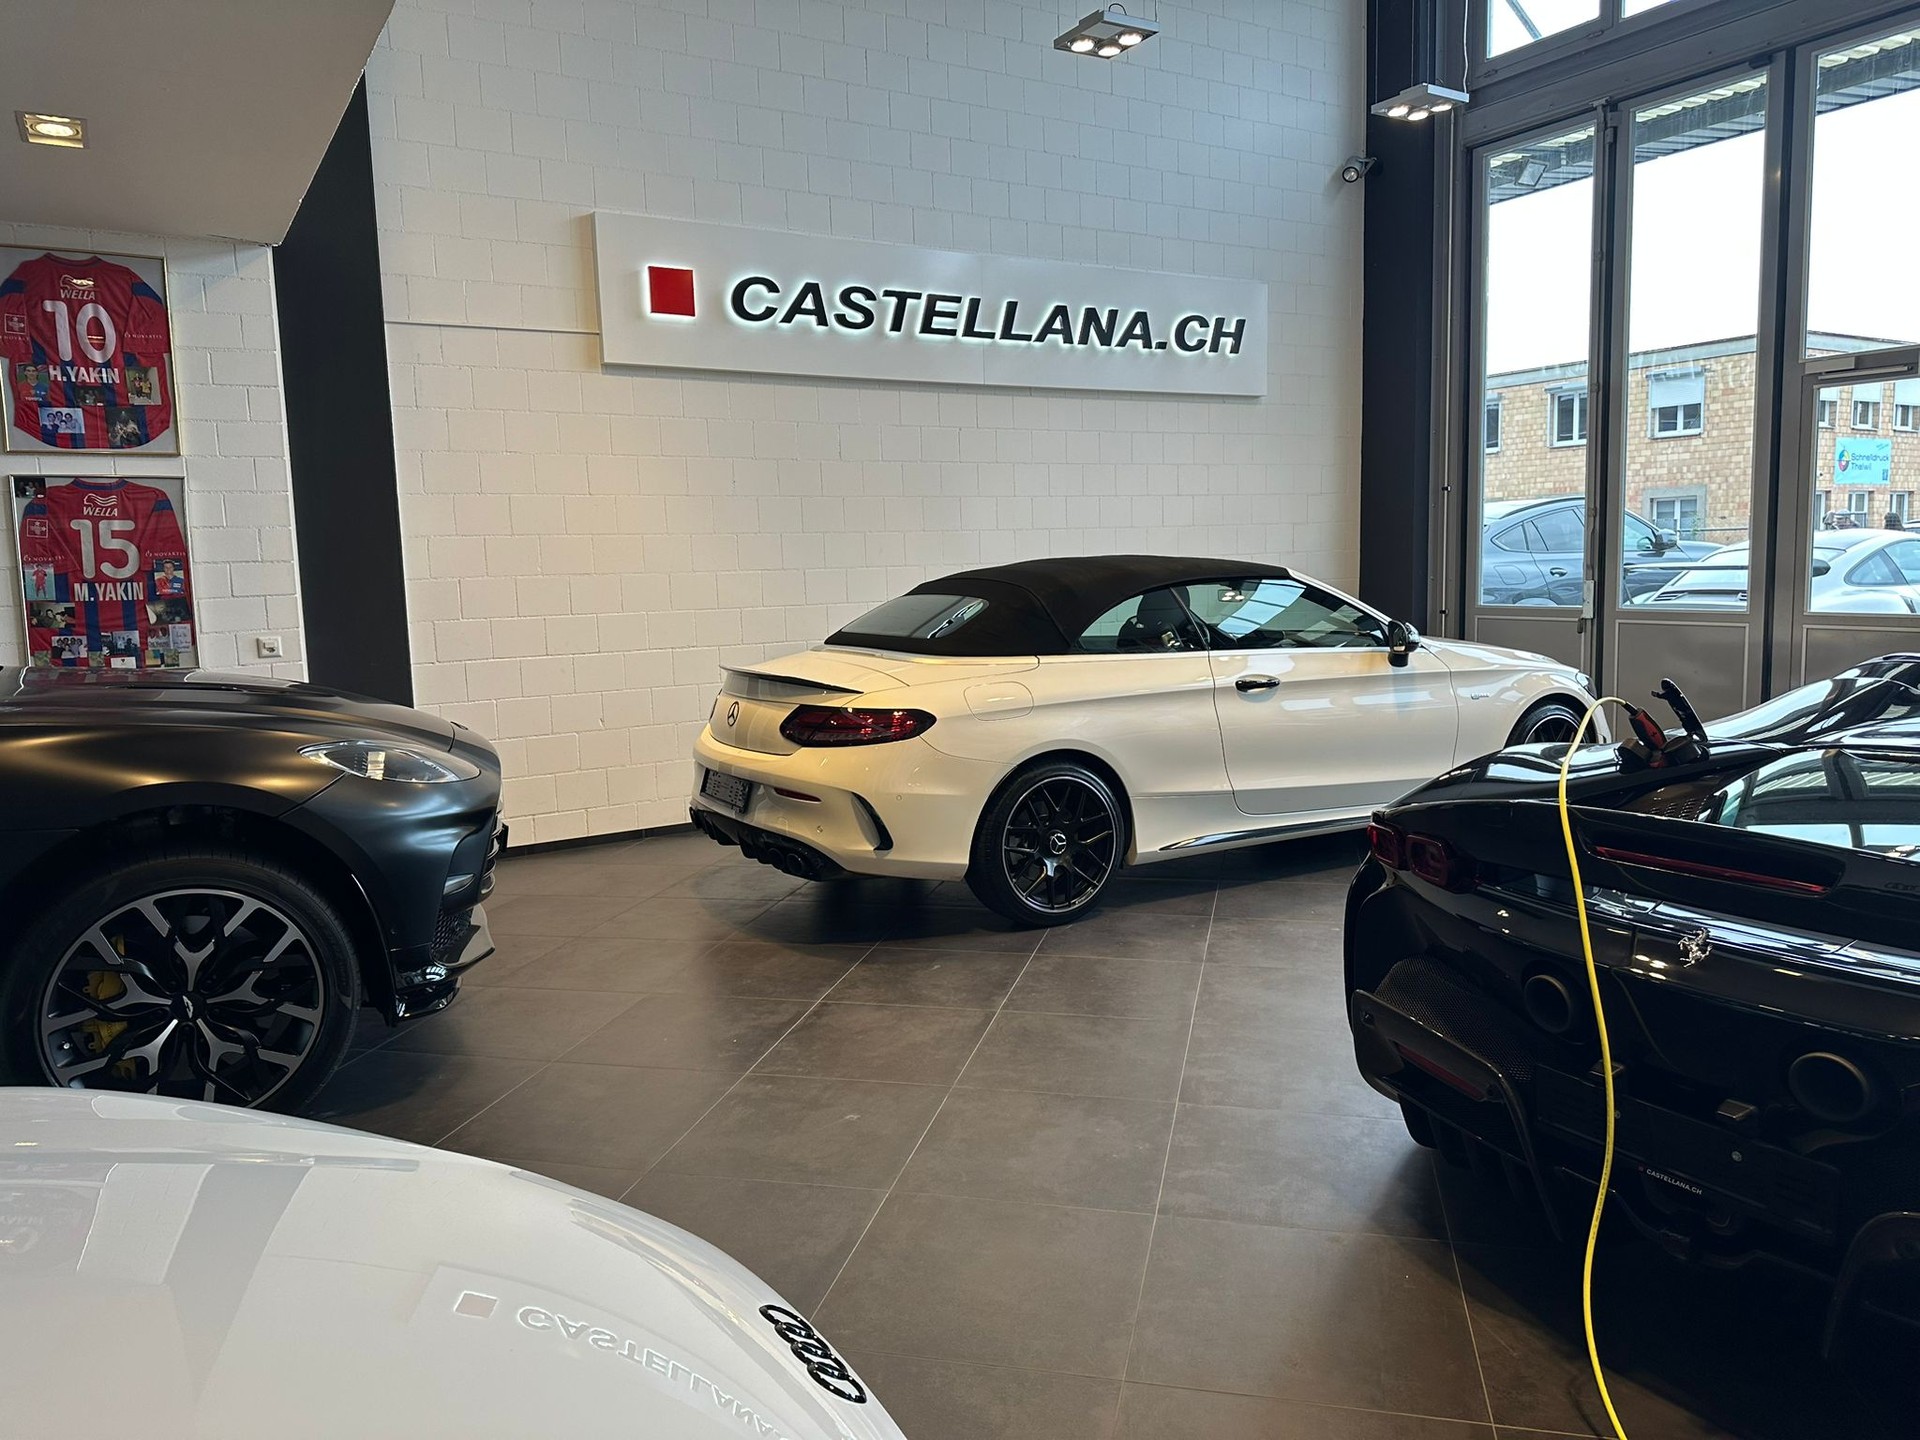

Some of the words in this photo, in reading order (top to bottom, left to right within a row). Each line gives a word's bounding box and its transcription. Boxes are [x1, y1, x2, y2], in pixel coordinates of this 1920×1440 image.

[61, 289, 95, 300] WELLA
[731, 276, 1246, 355] CASTELLANA.CH
[43, 300, 116, 363] 10
[49, 365, 120, 383] H.YAKIN
[83, 506, 118, 517] WELLA
[70, 519, 140, 579] 15
[74, 582, 144, 601] M.YAKIN
[1647, 1168, 1703, 1195] CASTELLANA.CH
